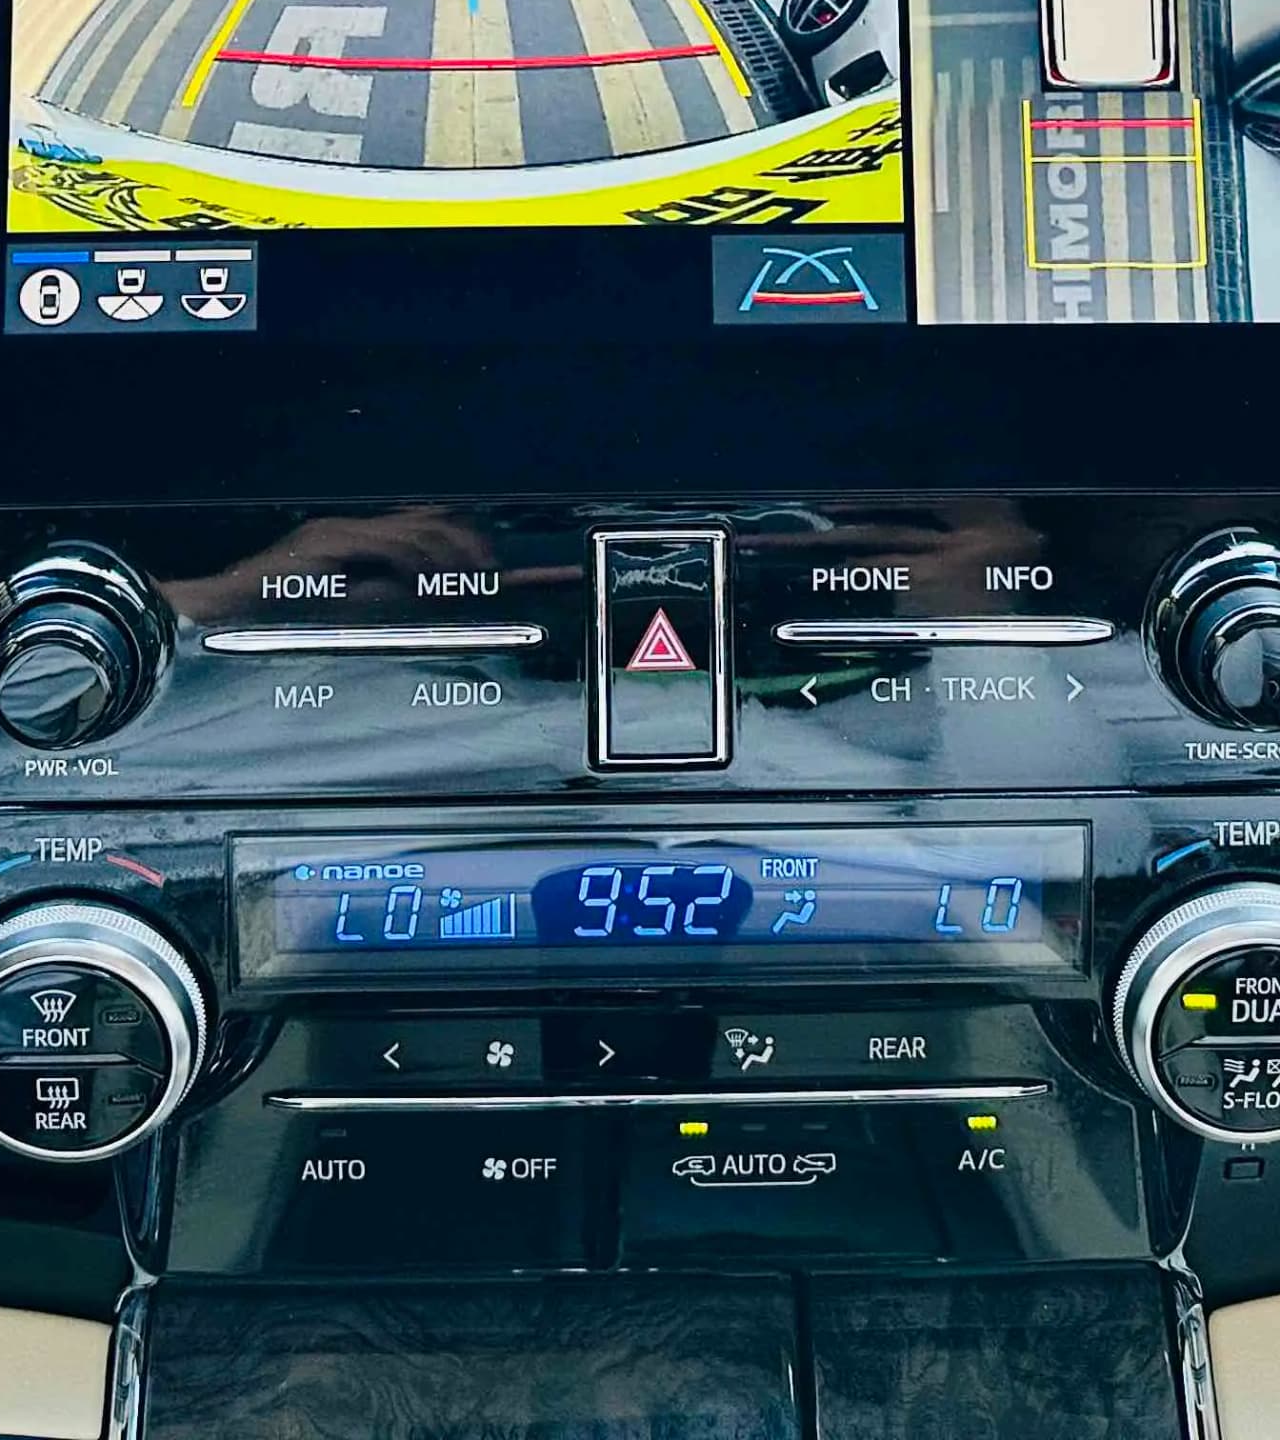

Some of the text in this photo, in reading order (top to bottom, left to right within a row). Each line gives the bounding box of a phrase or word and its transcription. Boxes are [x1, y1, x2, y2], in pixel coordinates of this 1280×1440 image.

[262, 574, 347, 599] HOME
[418, 572, 499, 597] MENU
[812, 567, 910, 591] PHONE
[986, 566, 1053, 591] INFO
[274, 685, 334, 709] MAP
[411, 681, 502, 707] AUDIO
[871, 676, 1036, 702] CH TRACK
[1214, 820, 1280, 847] TEMP
[34, 837, 103, 863] TEMP
[323, 863, 424, 880] nanoe
[761, 858, 818, 879] FRONT
[22, 1027, 90, 1048] FRONT
[869, 1036, 927, 1059] REAR
[35, 1111, 87, 1130] REAR
[301, 1159, 366, 1181] AUTO
[511, 1157, 557, 1179] OFF
[721, 1154, 787, 1176] AUTO
[958, 1148, 1006, 1171] A/C
